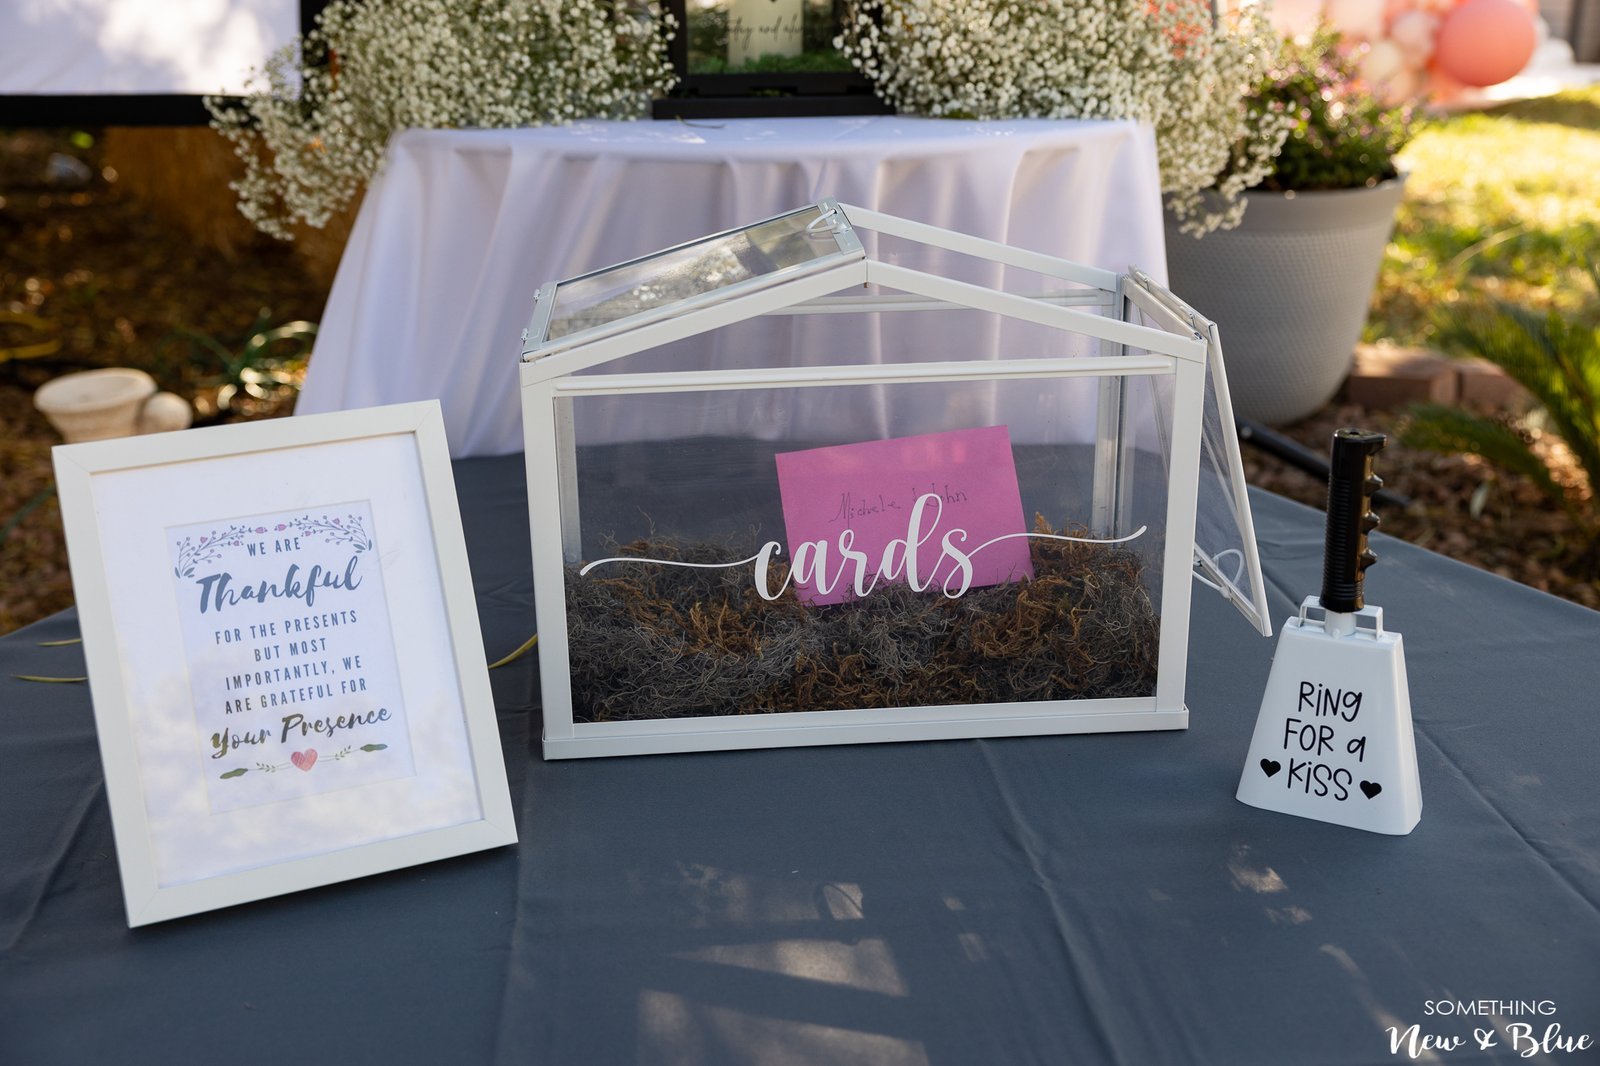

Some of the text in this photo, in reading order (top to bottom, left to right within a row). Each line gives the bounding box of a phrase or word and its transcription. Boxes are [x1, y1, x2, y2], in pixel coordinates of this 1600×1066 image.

[247, 537, 302, 557] WE ARE
[195, 555, 363, 614] Thankful
[215, 609, 358, 645] FOR THE PRESENTS
[254, 638, 327, 662] BUT MOST
[225, 655, 362, 691] IMPORTANTLY, WE
[225, 678, 367, 715] ARE GRATEFUL FOR
[210, 707, 392, 759] Your Presence
[1283, 718, 1367, 763] FOR a
